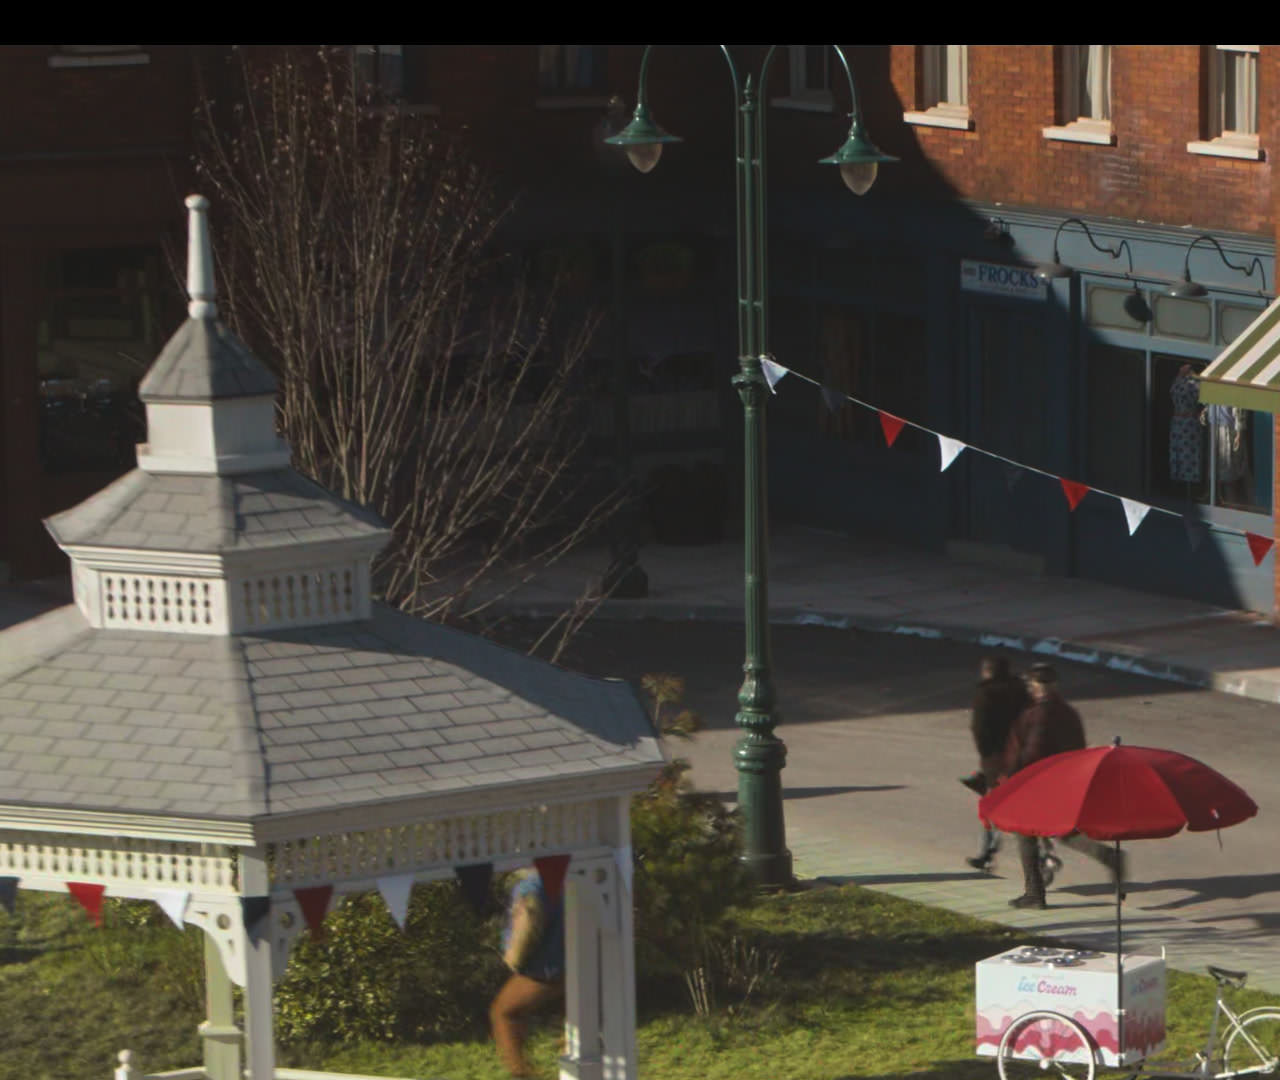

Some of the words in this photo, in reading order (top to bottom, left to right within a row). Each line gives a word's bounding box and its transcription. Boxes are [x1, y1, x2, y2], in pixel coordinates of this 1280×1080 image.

[978, 264, 1038, 289] FROCKS
[1018, 976, 1036, 993] Ice
[1037, 980, 1078, 997] Cream
